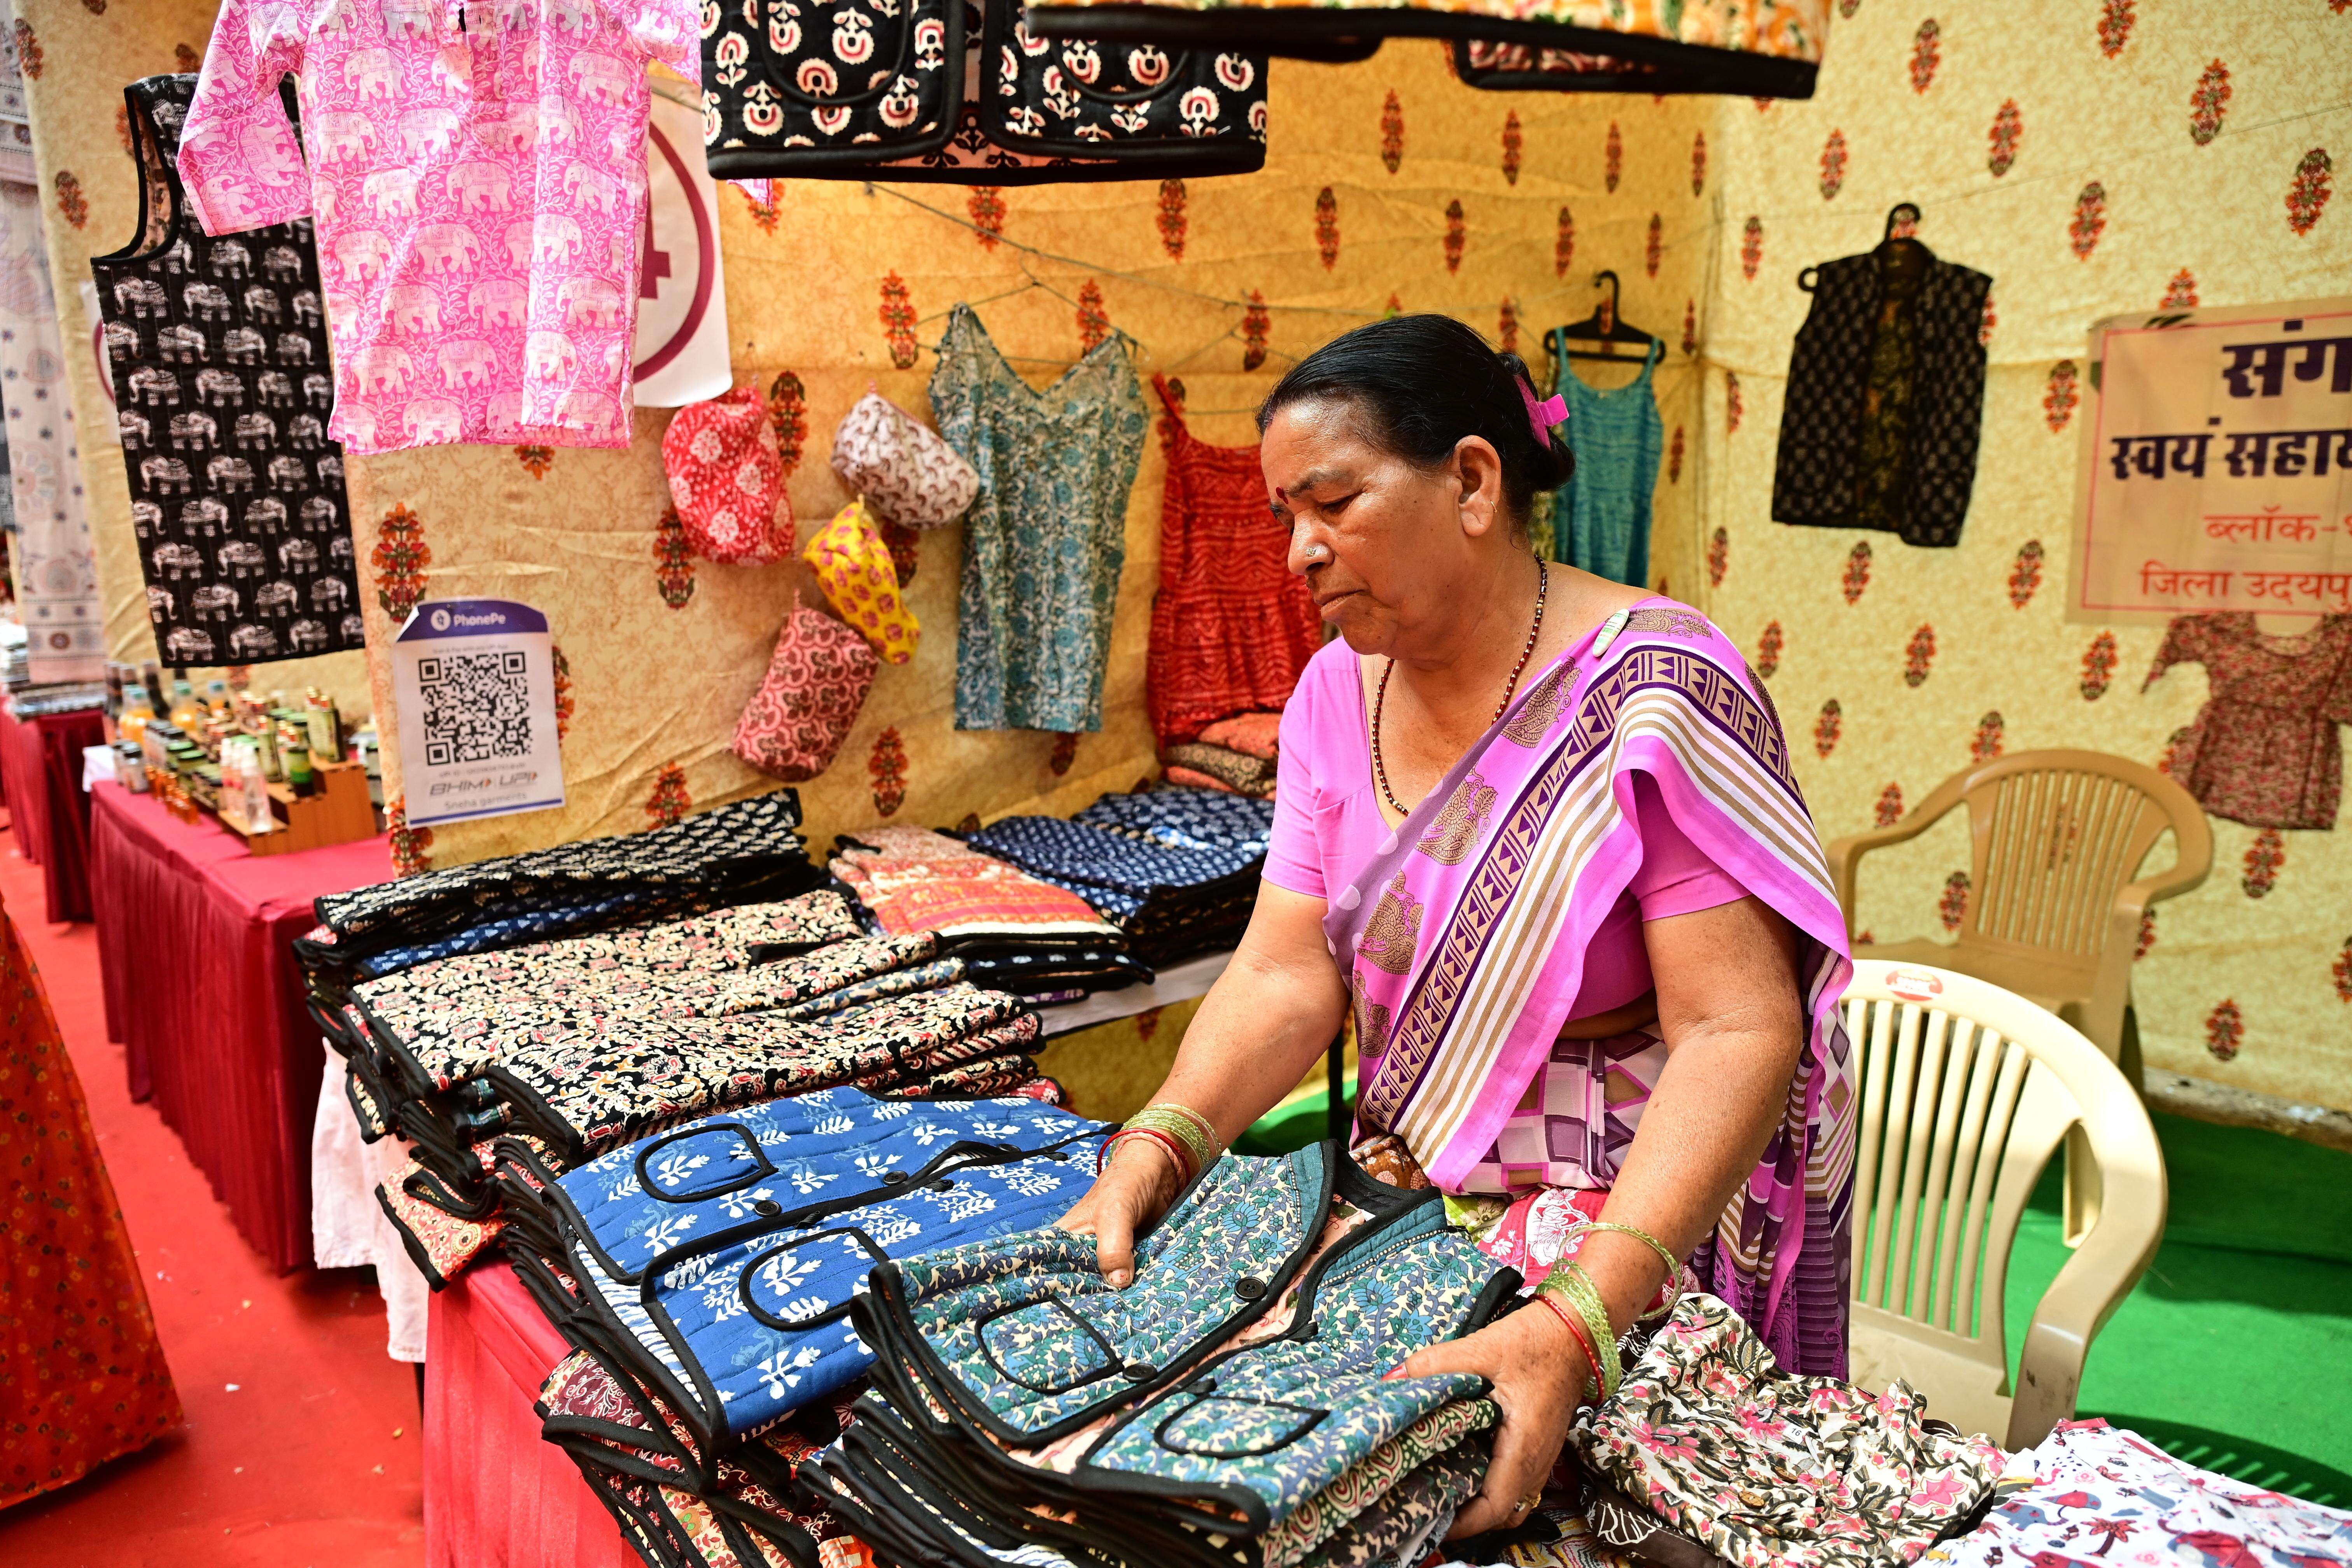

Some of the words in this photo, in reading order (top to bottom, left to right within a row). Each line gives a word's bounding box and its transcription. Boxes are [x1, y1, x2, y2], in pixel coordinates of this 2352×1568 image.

[2222, 318, 2352, 397] संग
[2111, 417, 2221, 479] स्वयं
[2203, 504, 2352, 544] ब्लॉक-
[2139, 559, 2233, 599] जिला
[453, 612, 506, 627] PhonePe
[430, 779, 485, 796] BHIM
[1791, 1428, 1802, 1437] 16
